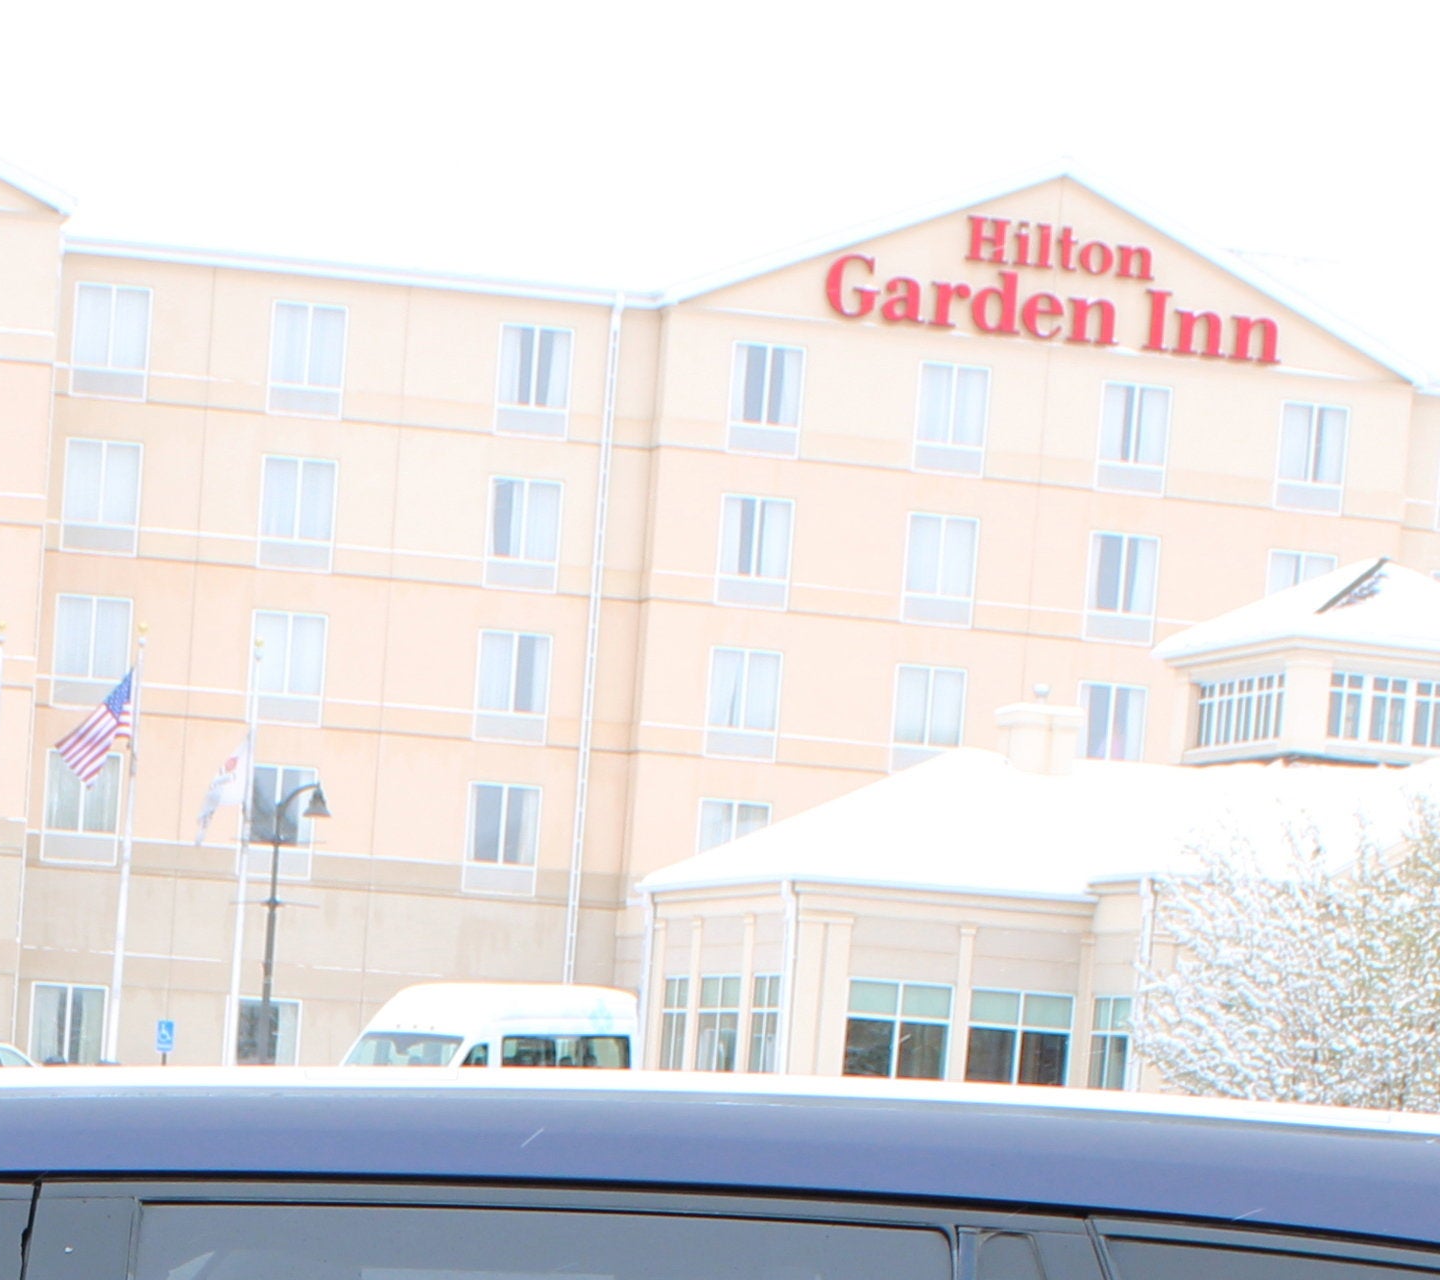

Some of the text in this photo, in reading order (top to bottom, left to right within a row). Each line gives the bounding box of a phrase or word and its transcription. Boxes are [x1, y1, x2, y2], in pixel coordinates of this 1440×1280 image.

[965, 214, 1154, 281] Hilton
[825, 253, 1281, 364] Garden Inn
